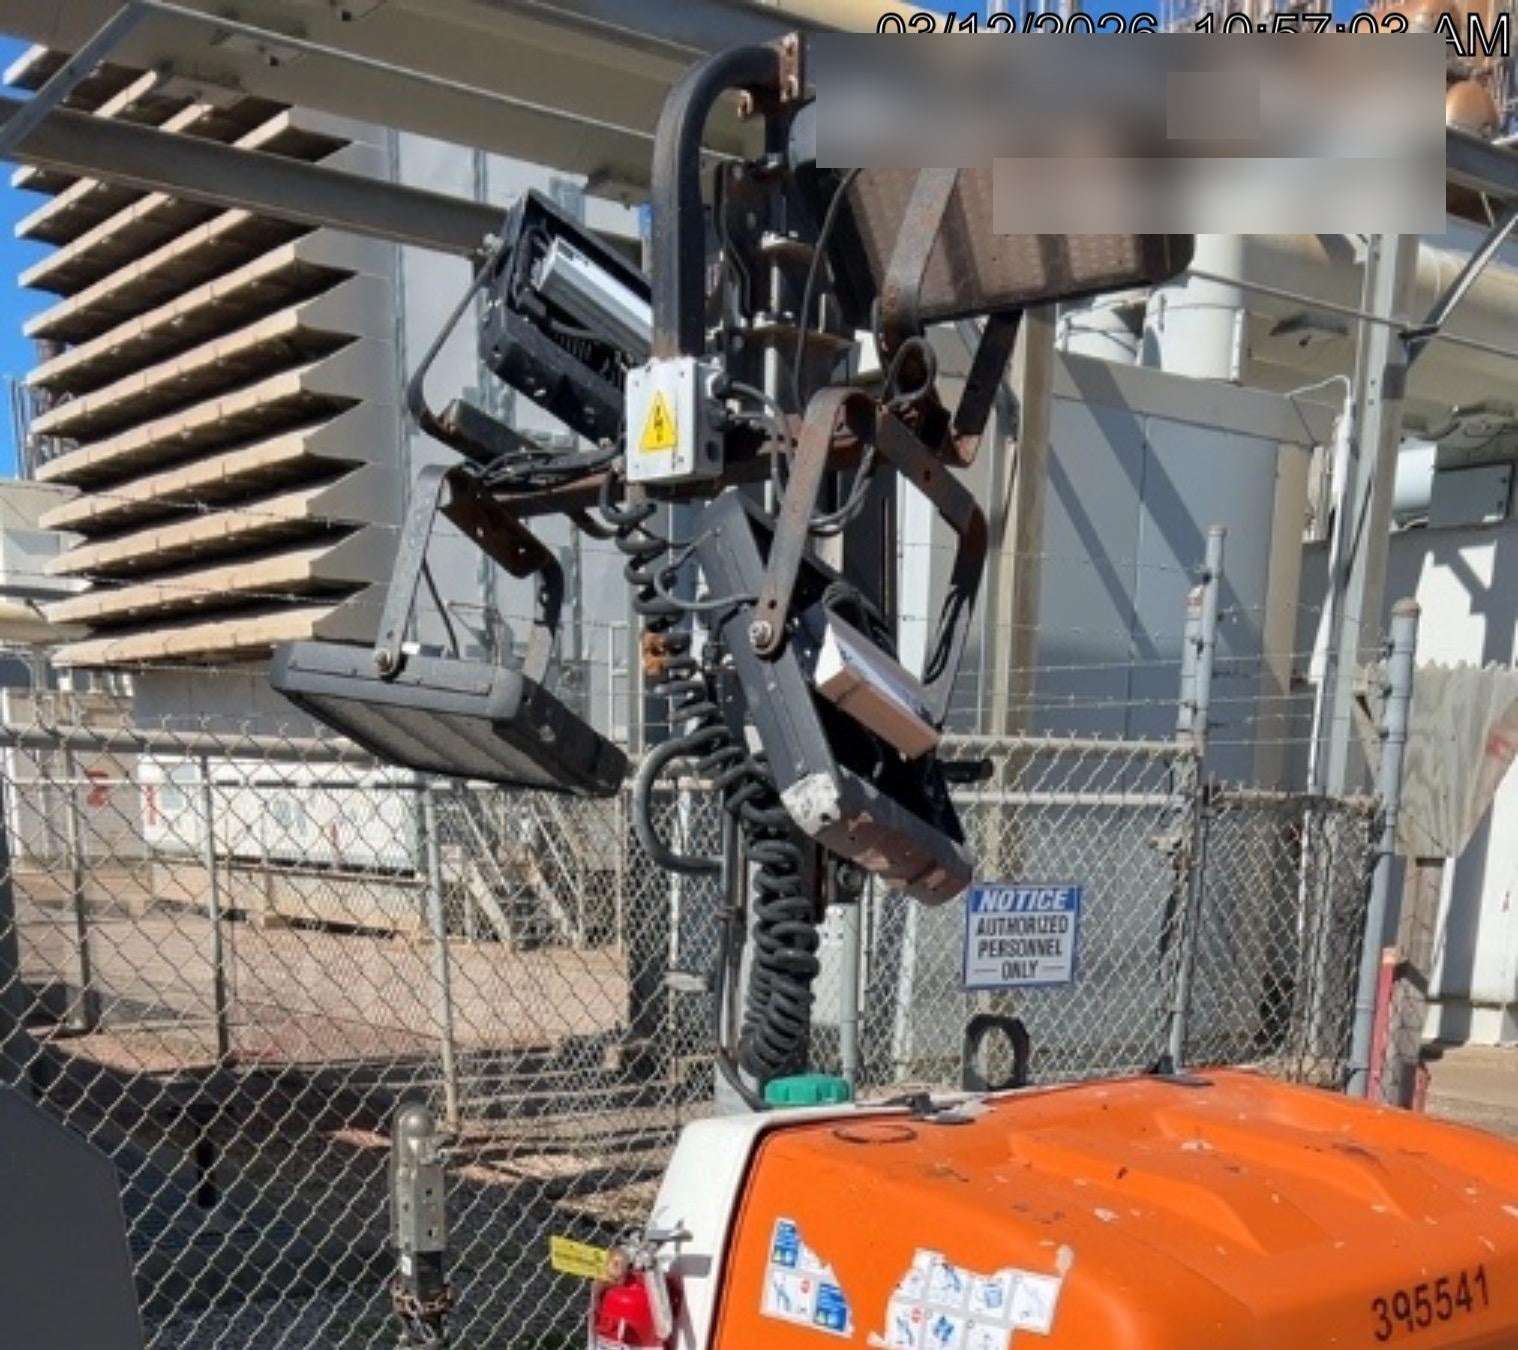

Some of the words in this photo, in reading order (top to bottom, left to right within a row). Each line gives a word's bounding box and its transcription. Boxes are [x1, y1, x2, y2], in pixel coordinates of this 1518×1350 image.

[978, 889, 1070, 912] NOTICE
[976, 914, 1068, 937] AUTHORIZED
[977, 938, 1063, 959] PERSONNEL
[1001, 960, 1039, 980] ONLY
[1371, 1263, 1489, 1342] 395541
